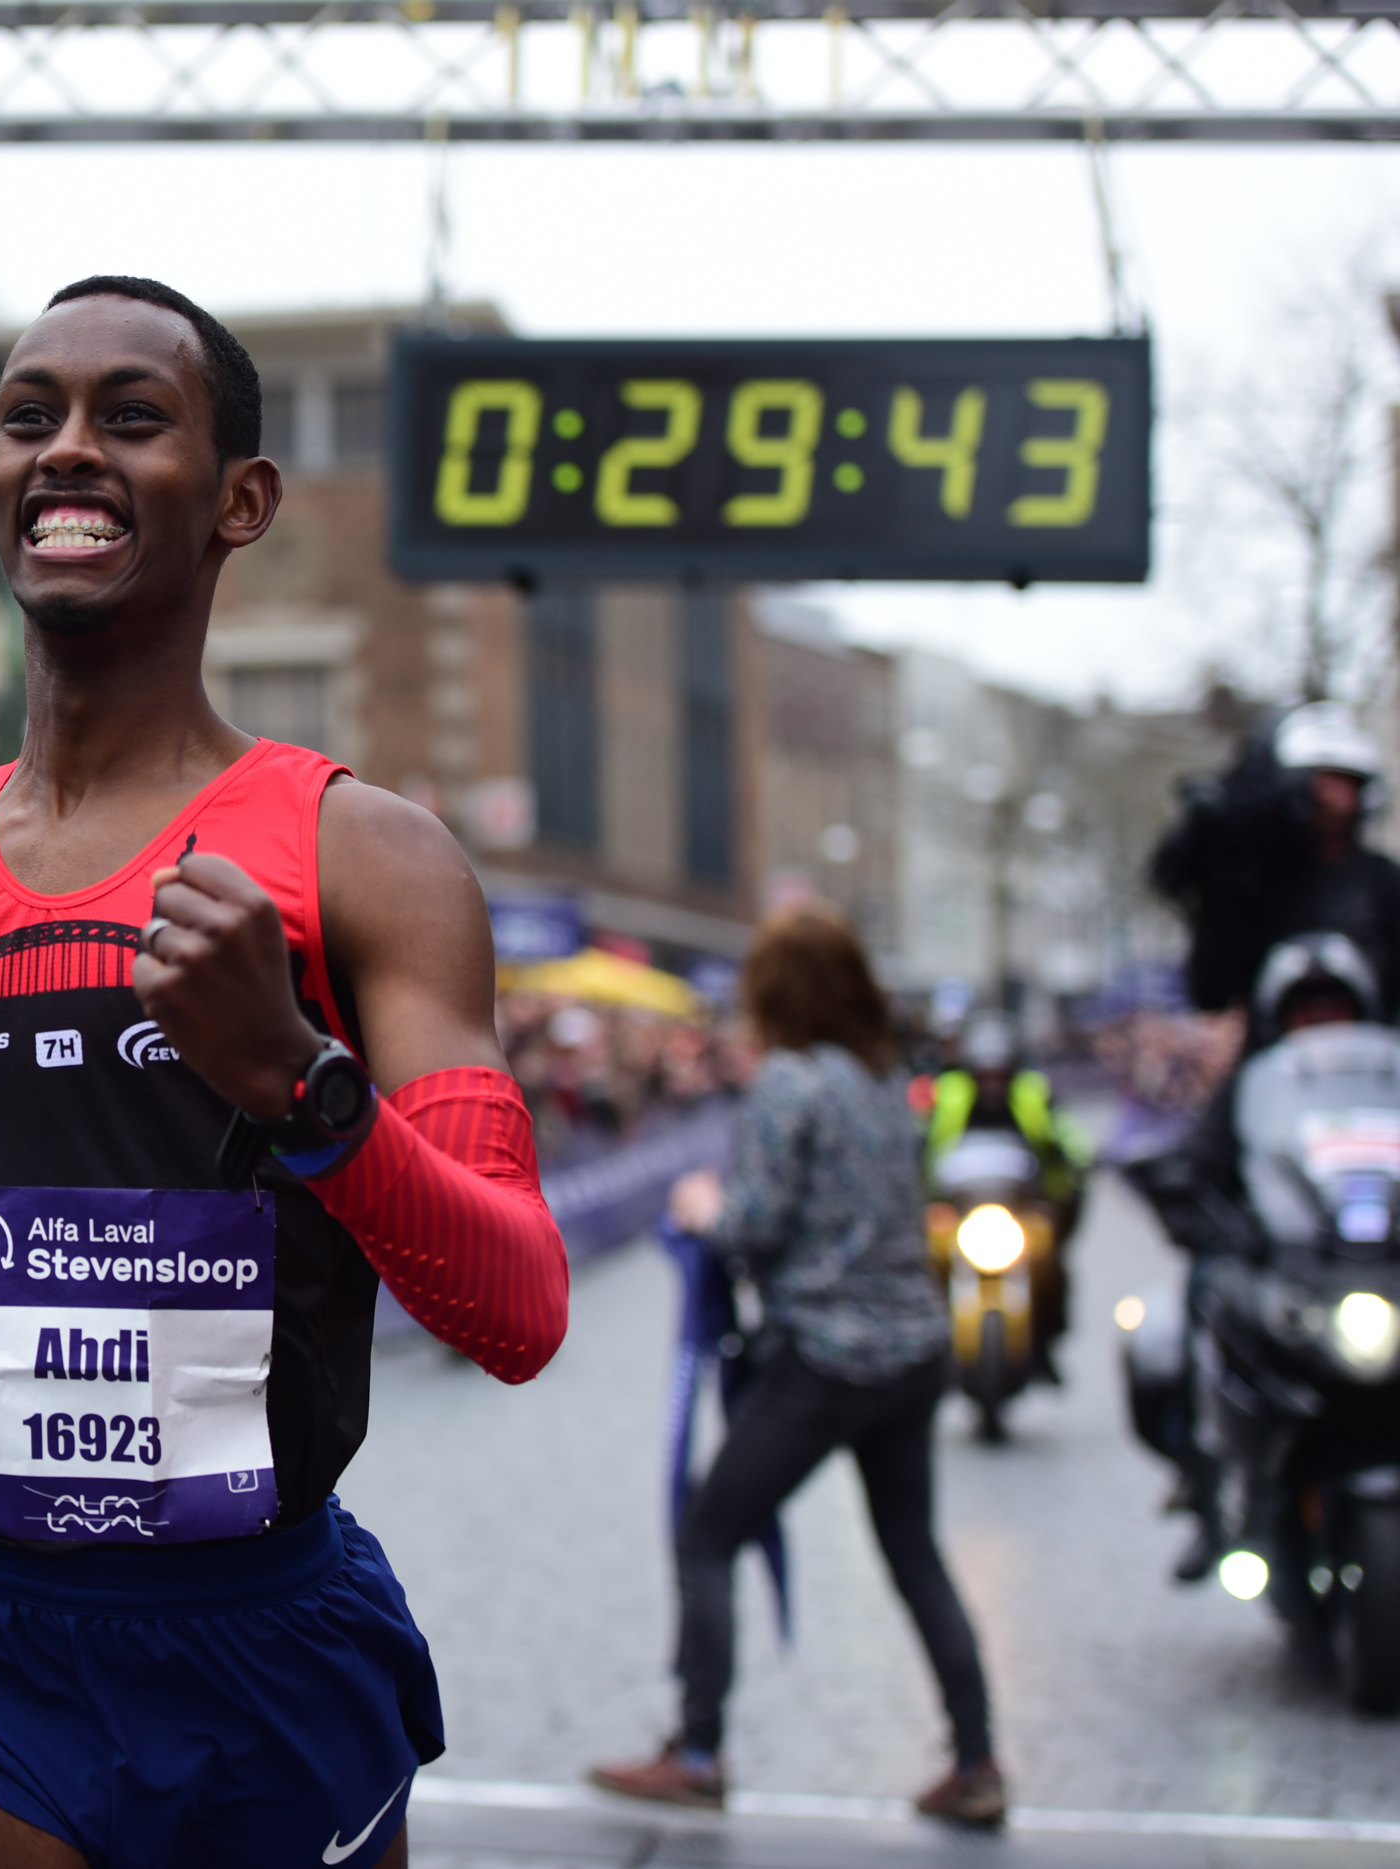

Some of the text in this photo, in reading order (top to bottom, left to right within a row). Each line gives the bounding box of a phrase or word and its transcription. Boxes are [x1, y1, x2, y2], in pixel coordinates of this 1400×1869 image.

[436, 381, 1108, 526] 0:29:43
[27, 1217, 155, 1244] Alfa Laval
[26, 1248, 259, 1290] Stevensloop
[33, 1327, 150, 1383] Abdi
[22, 1412, 163, 1466] 16923
[46, 1511, 154, 1537] LAVAL
[54, 1494, 140, 1516] ALFA
